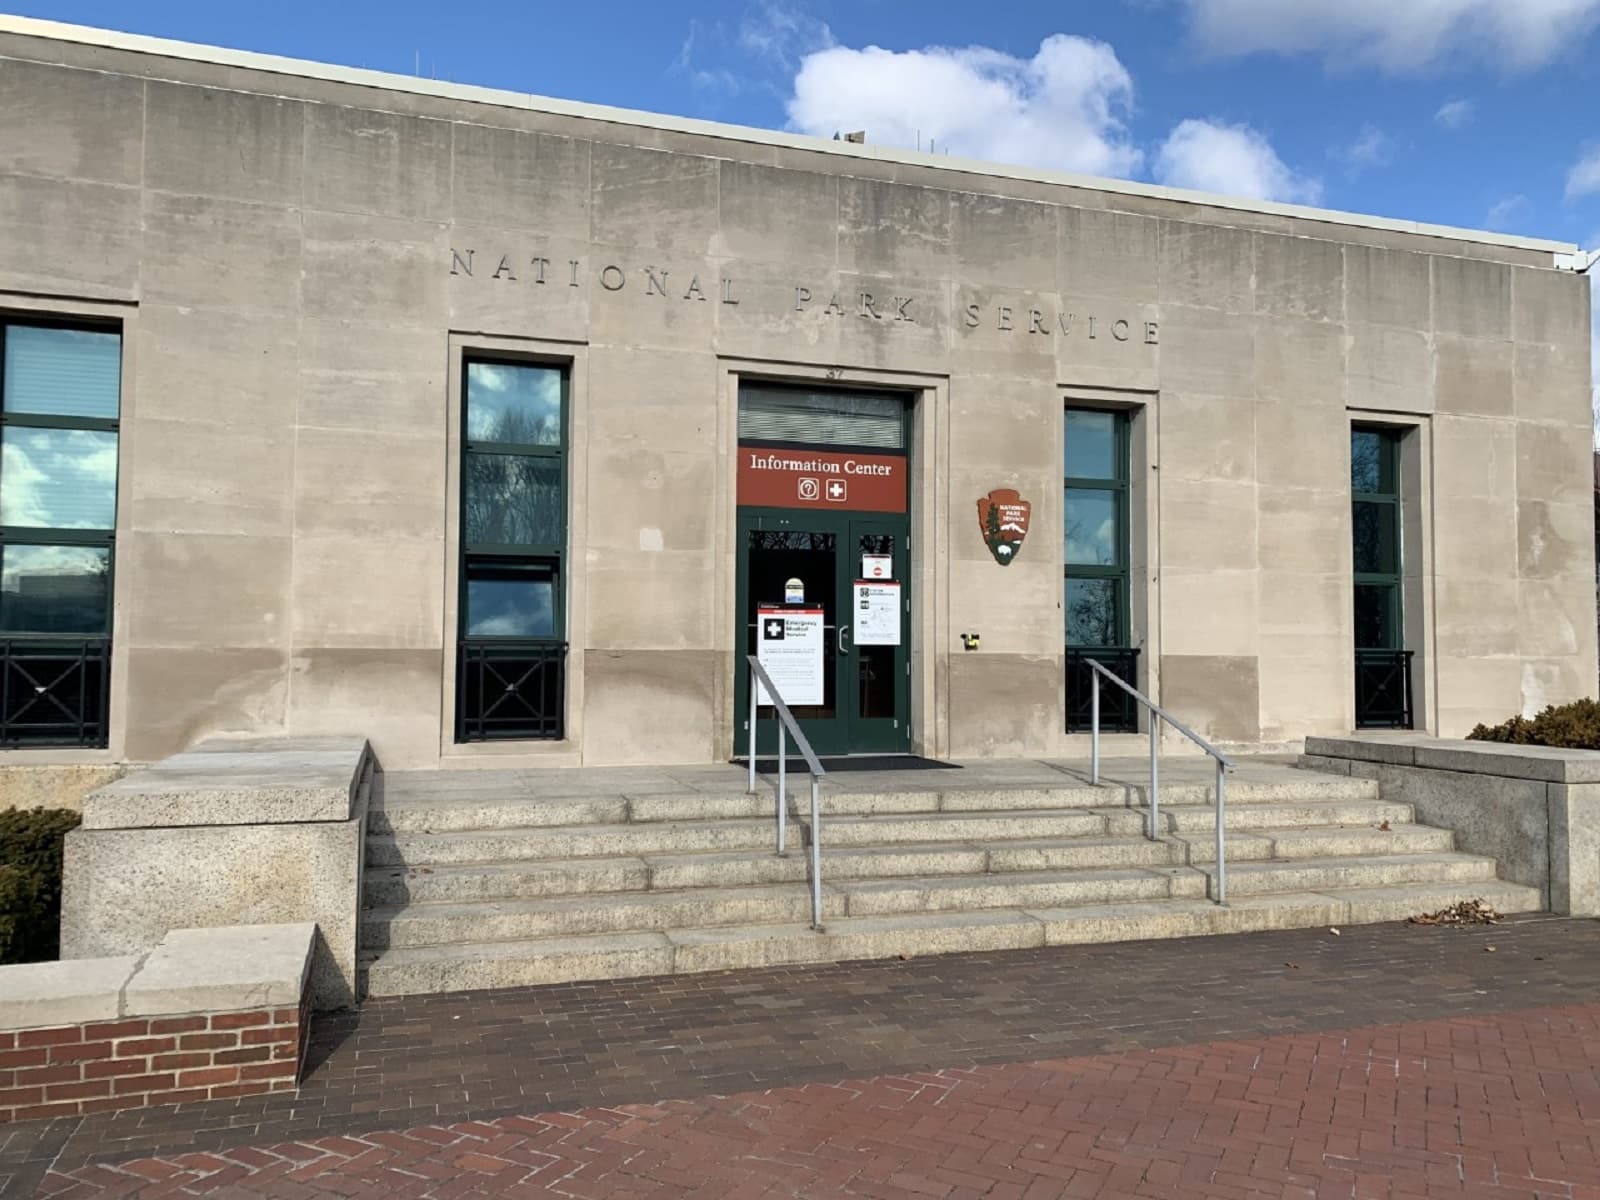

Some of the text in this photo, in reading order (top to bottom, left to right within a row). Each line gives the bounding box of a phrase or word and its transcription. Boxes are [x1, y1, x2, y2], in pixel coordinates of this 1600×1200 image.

[450, 248, 1160, 345] NATIONAL PARK SERVICE
[750, 454, 892, 476] Information Center
